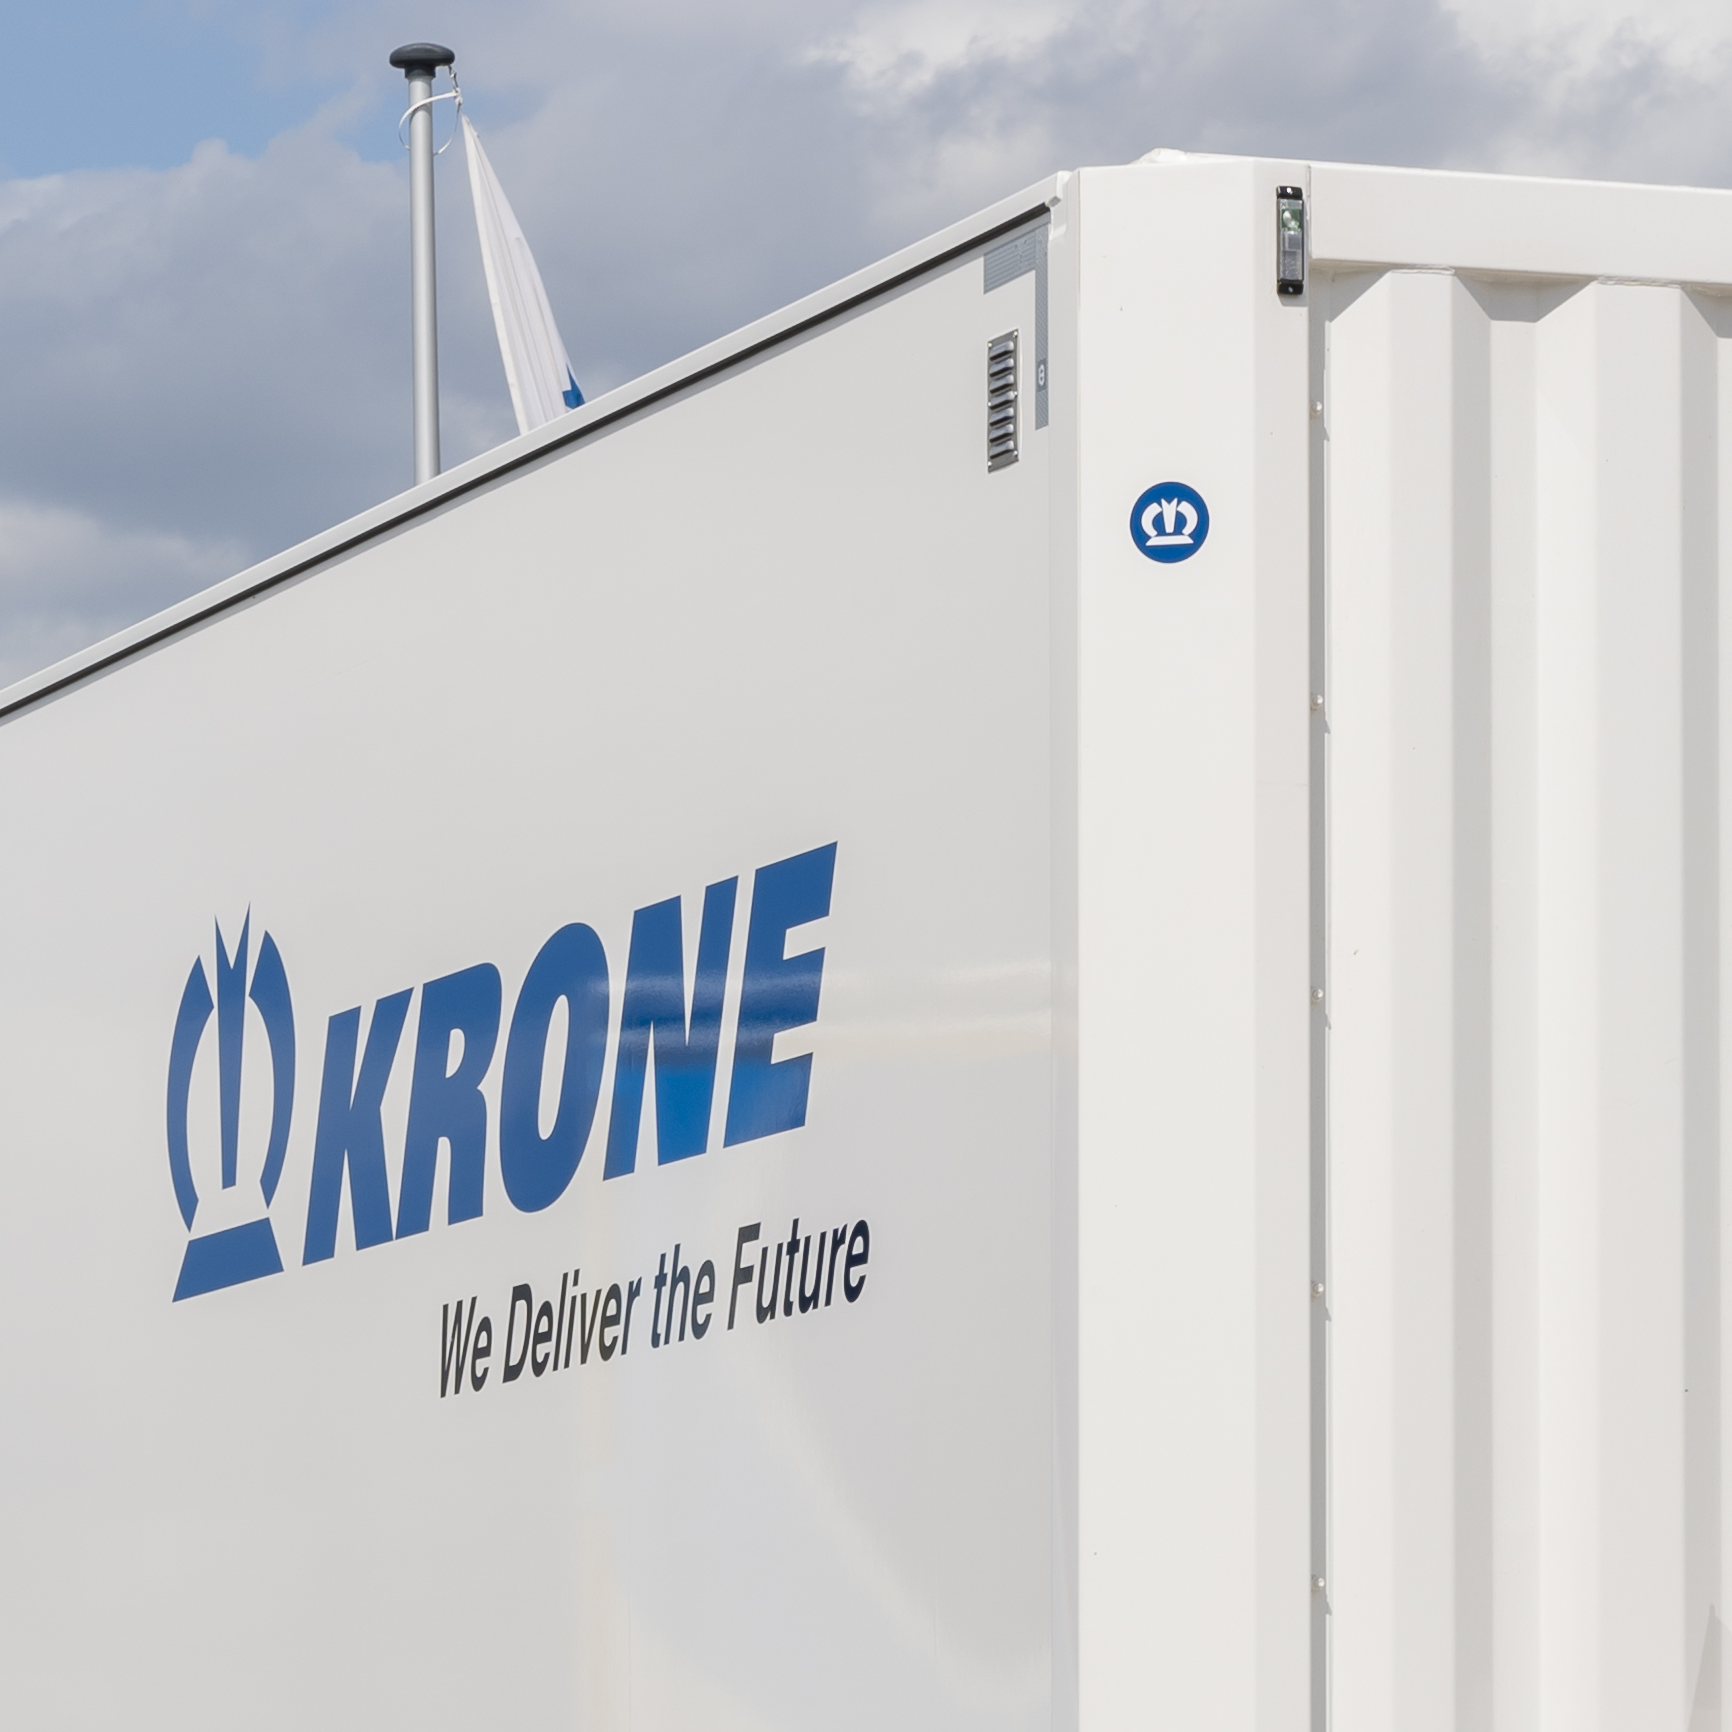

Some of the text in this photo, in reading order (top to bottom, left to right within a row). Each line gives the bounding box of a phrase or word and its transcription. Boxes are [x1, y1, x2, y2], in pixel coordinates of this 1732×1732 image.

[302, 841, 837, 1266] KRONE
[440, 1217, 870, 1398] We Deliver the Future
